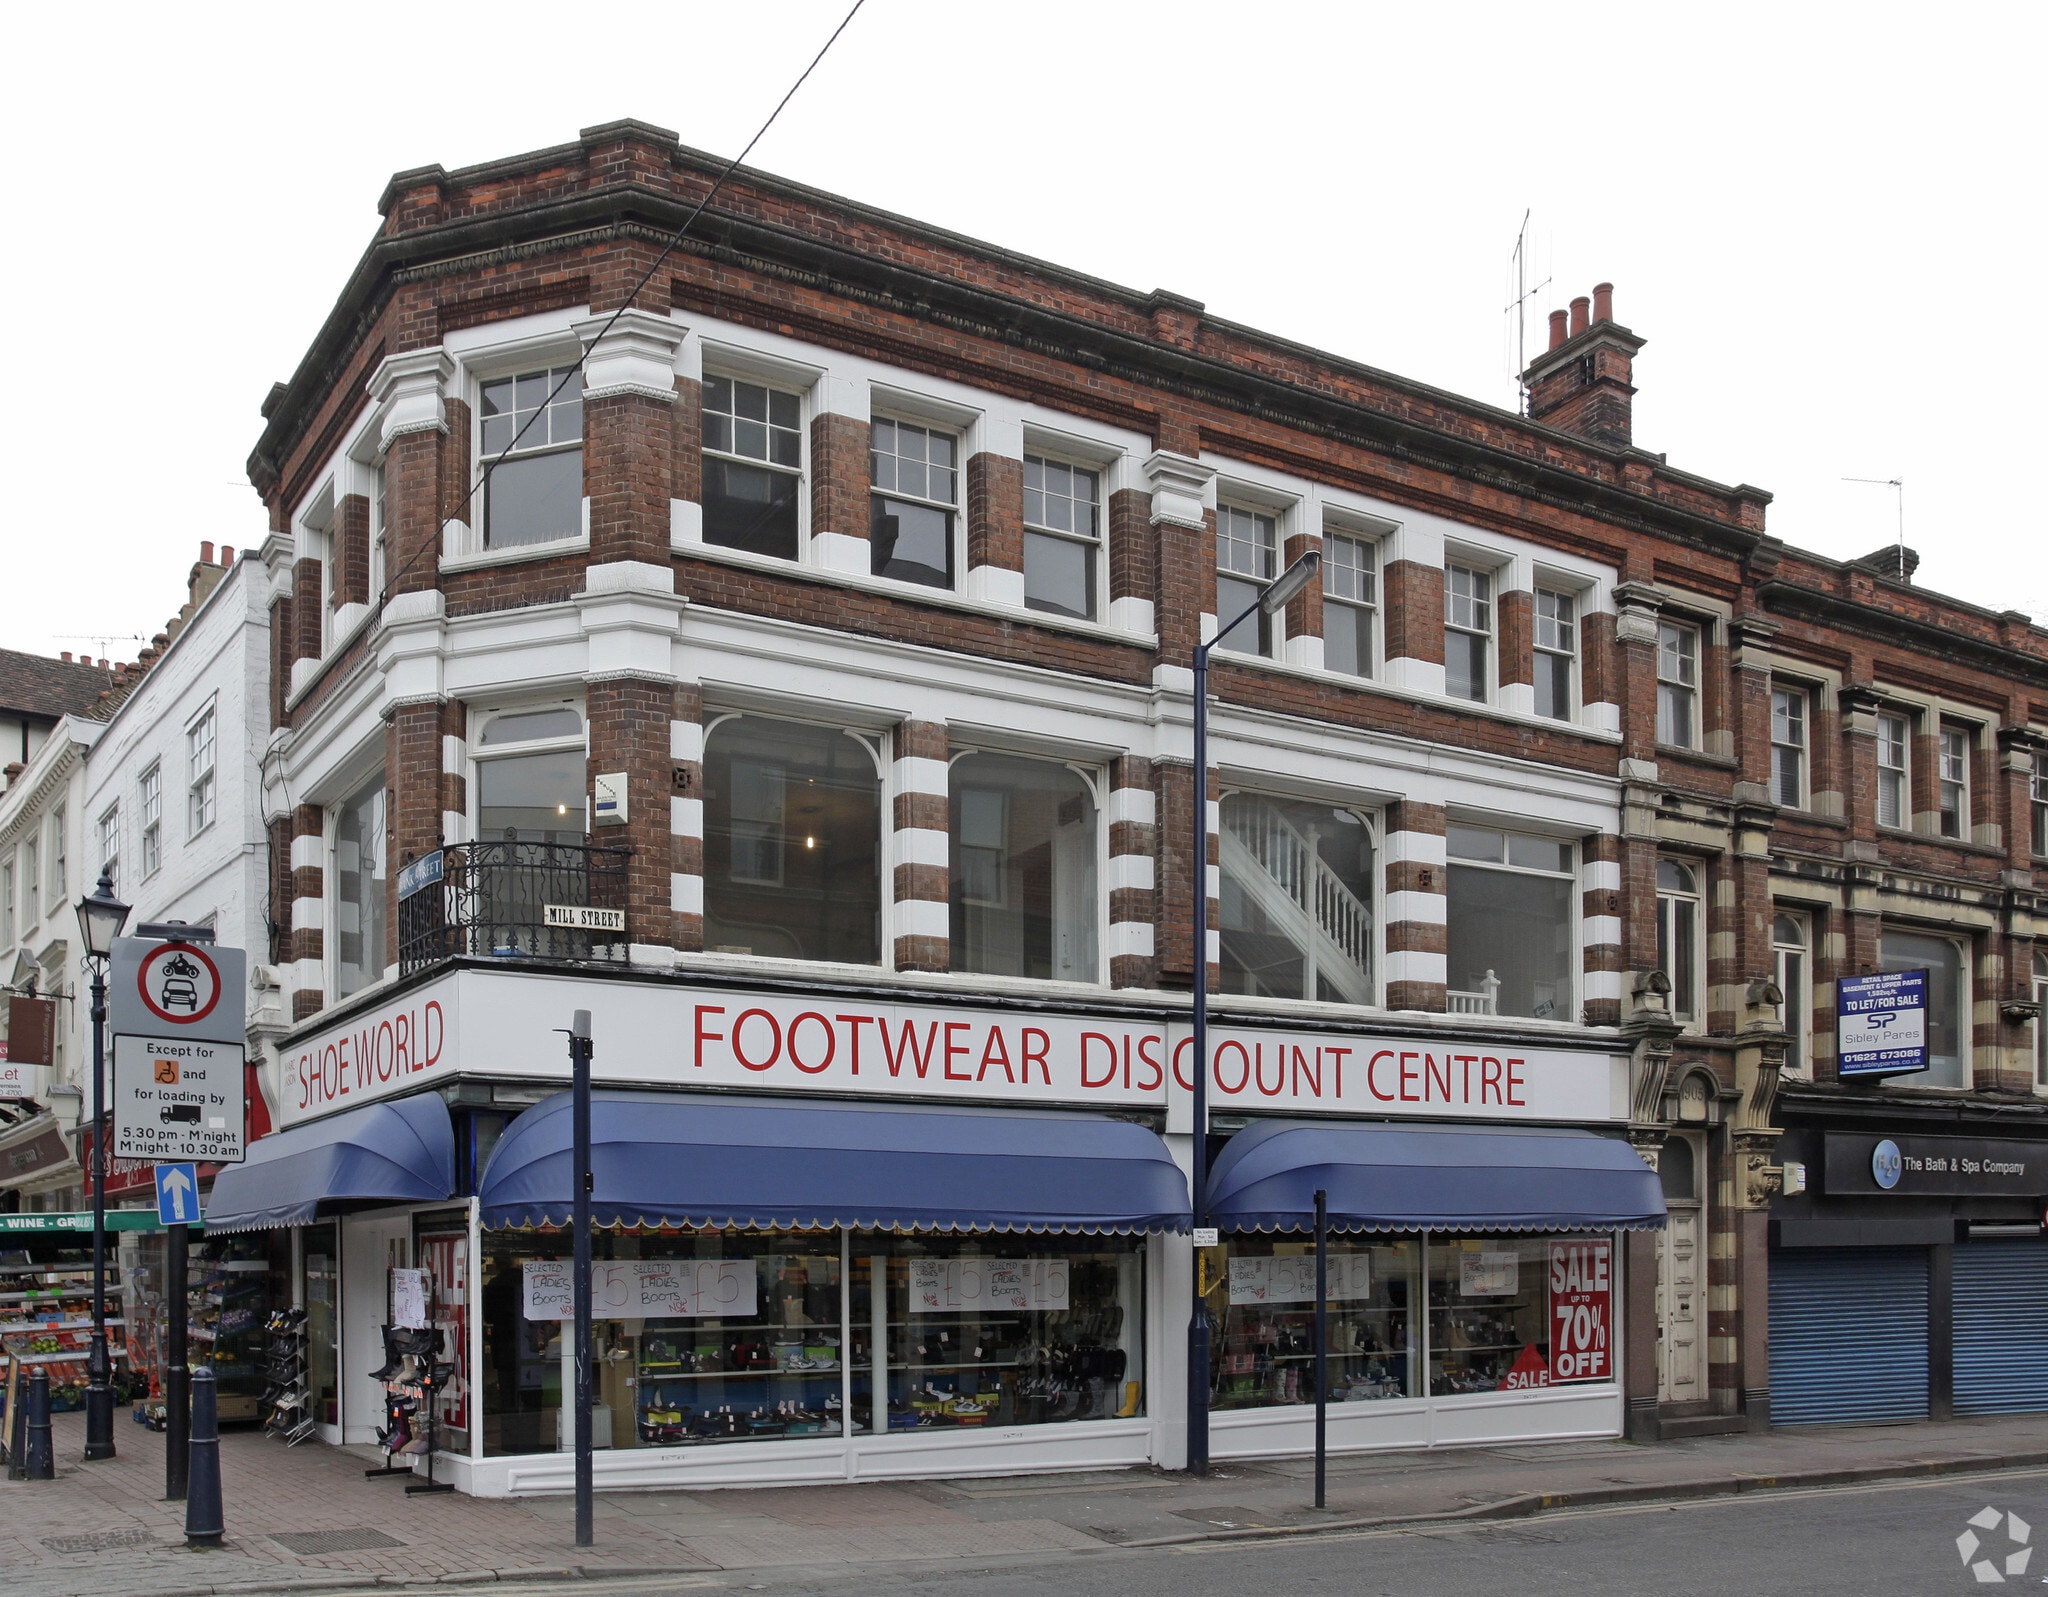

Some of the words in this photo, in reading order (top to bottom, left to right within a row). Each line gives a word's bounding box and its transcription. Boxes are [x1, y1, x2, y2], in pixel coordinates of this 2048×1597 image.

[549, 908, 575, 924] MILL
[581, 910, 620, 927] STREET
[1846, 1001, 1858, 1011] TO
[1859, 997, 1896, 1010] LET/FOR
[1897, 994, 1919, 1006] SALE
[1845, 1034, 1879, 1046] Sibley
[1883, 1030, 1920, 1041] Pares
[147, 1043, 192, 1058] Except
[196, 1047, 214, 1058] for
[299, 1037, 350, 1109] SHOE
[354, 1000, 444, 1090] WORLD
[694, 1004, 1052, 1085] FOOTWEAR
[1080, 1032, 1353, 1098] DISCOUNT
[1367, 1050, 1526, 1107] CENTRE
[1844, 1052, 1877, 1063] 01622
[1880, 1049, 1921, 1060] 673086
[183, 1069, 206, 1080] and
[134, 1088, 153, 1099] for
[158, 1090, 205, 1104] loading
[210, 1093, 225, 1105] by
[123, 1127, 155, 1138] 5.30
[158, 1131, 178, 1141] pm
[180, 1143, 217, 1155] 10.30
[220, 1148, 239, 1156] am
[1903, 1157, 1922, 1171] The
[1925, 1157, 1947, 1171] Bath
[1950, 1159, 1958, 1172] &
[1961, 1158, 1979, 1174] Spa
[1983, 1159, 2024, 1176] Company
[7, 1218, 45, 1228] WINE
[525, 1263, 563, 1273] SELECTED
[633, 1263, 672, 1275] SELECTED
[1336, 1256, 1367, 1294] £5
[1551, 1246, 1609, 1294] SALE
[532, 1277, 571, 1290] LADIES
[641, 1277, 680, 1288] LADIES
[944, 1261, 982, 1306] £5
[991, 1273, 1022, 1284] LADIES
[1032, 1262, 1067, 1302] £5
[1229, 1271, 1256, 1281] LADIES
[1267, 1257, 1296, 1296] £5
[691, 1262, 740, 1313] £5
[532, 1291, 572, 1306] BOOTS
[641, 1291, 681, 1304] BOOTS
[668, 1297, 688, 1312] NOW
[1570, 1295, 1580, 1303] UP
[1581, 1295, 1590, 1303] TO
[1557, 1304, 1605, 1351] 70%
[1557, 1352, 1605, 1377] OFF
[1506, 1370, 1548, 1390] SALE
